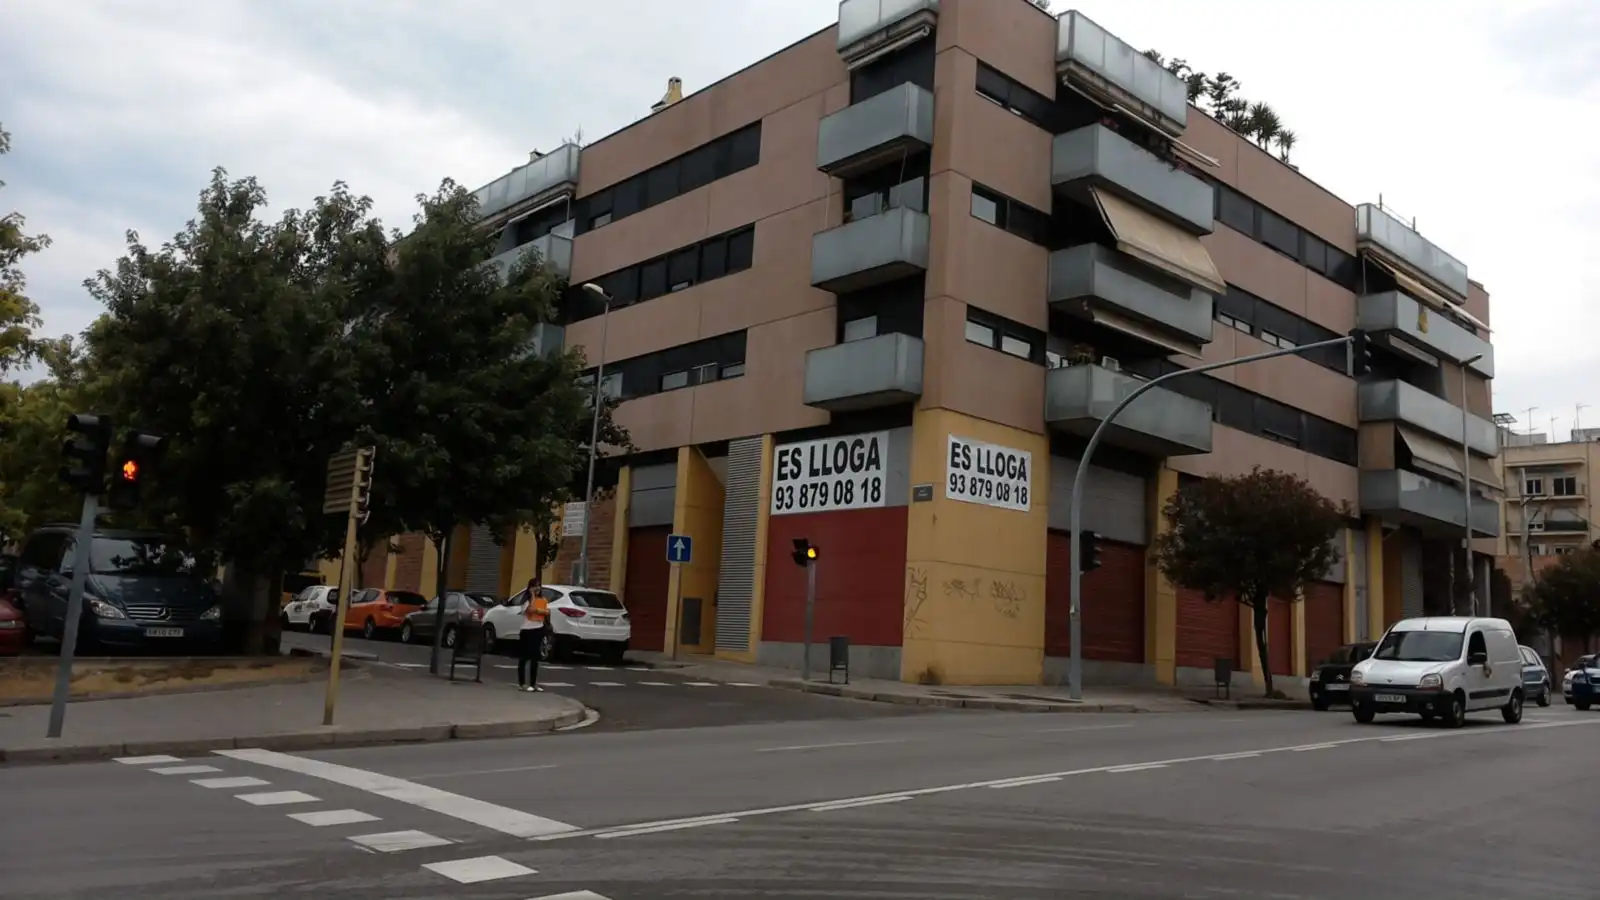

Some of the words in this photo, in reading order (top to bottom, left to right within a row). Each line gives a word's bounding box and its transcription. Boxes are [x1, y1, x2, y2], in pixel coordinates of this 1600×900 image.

[777, 447, 802, 481] ES
[809, 437, 881, 477] LLOGA
[950, 442, 971, 471] ES
[976, 449, 1027, 482] LLOGA
[776, 487, 793, 510] 93
[799, 483, 828, 507] 879
[834, 479, 854, 505] 08
[861, 477, 881, 503] 18
[950, 474, 966, 494] 93
[970, 478, 992, 499] 879
[996, 483, 1010, 502] 08
[1014, 487, 1028, 505] 18
